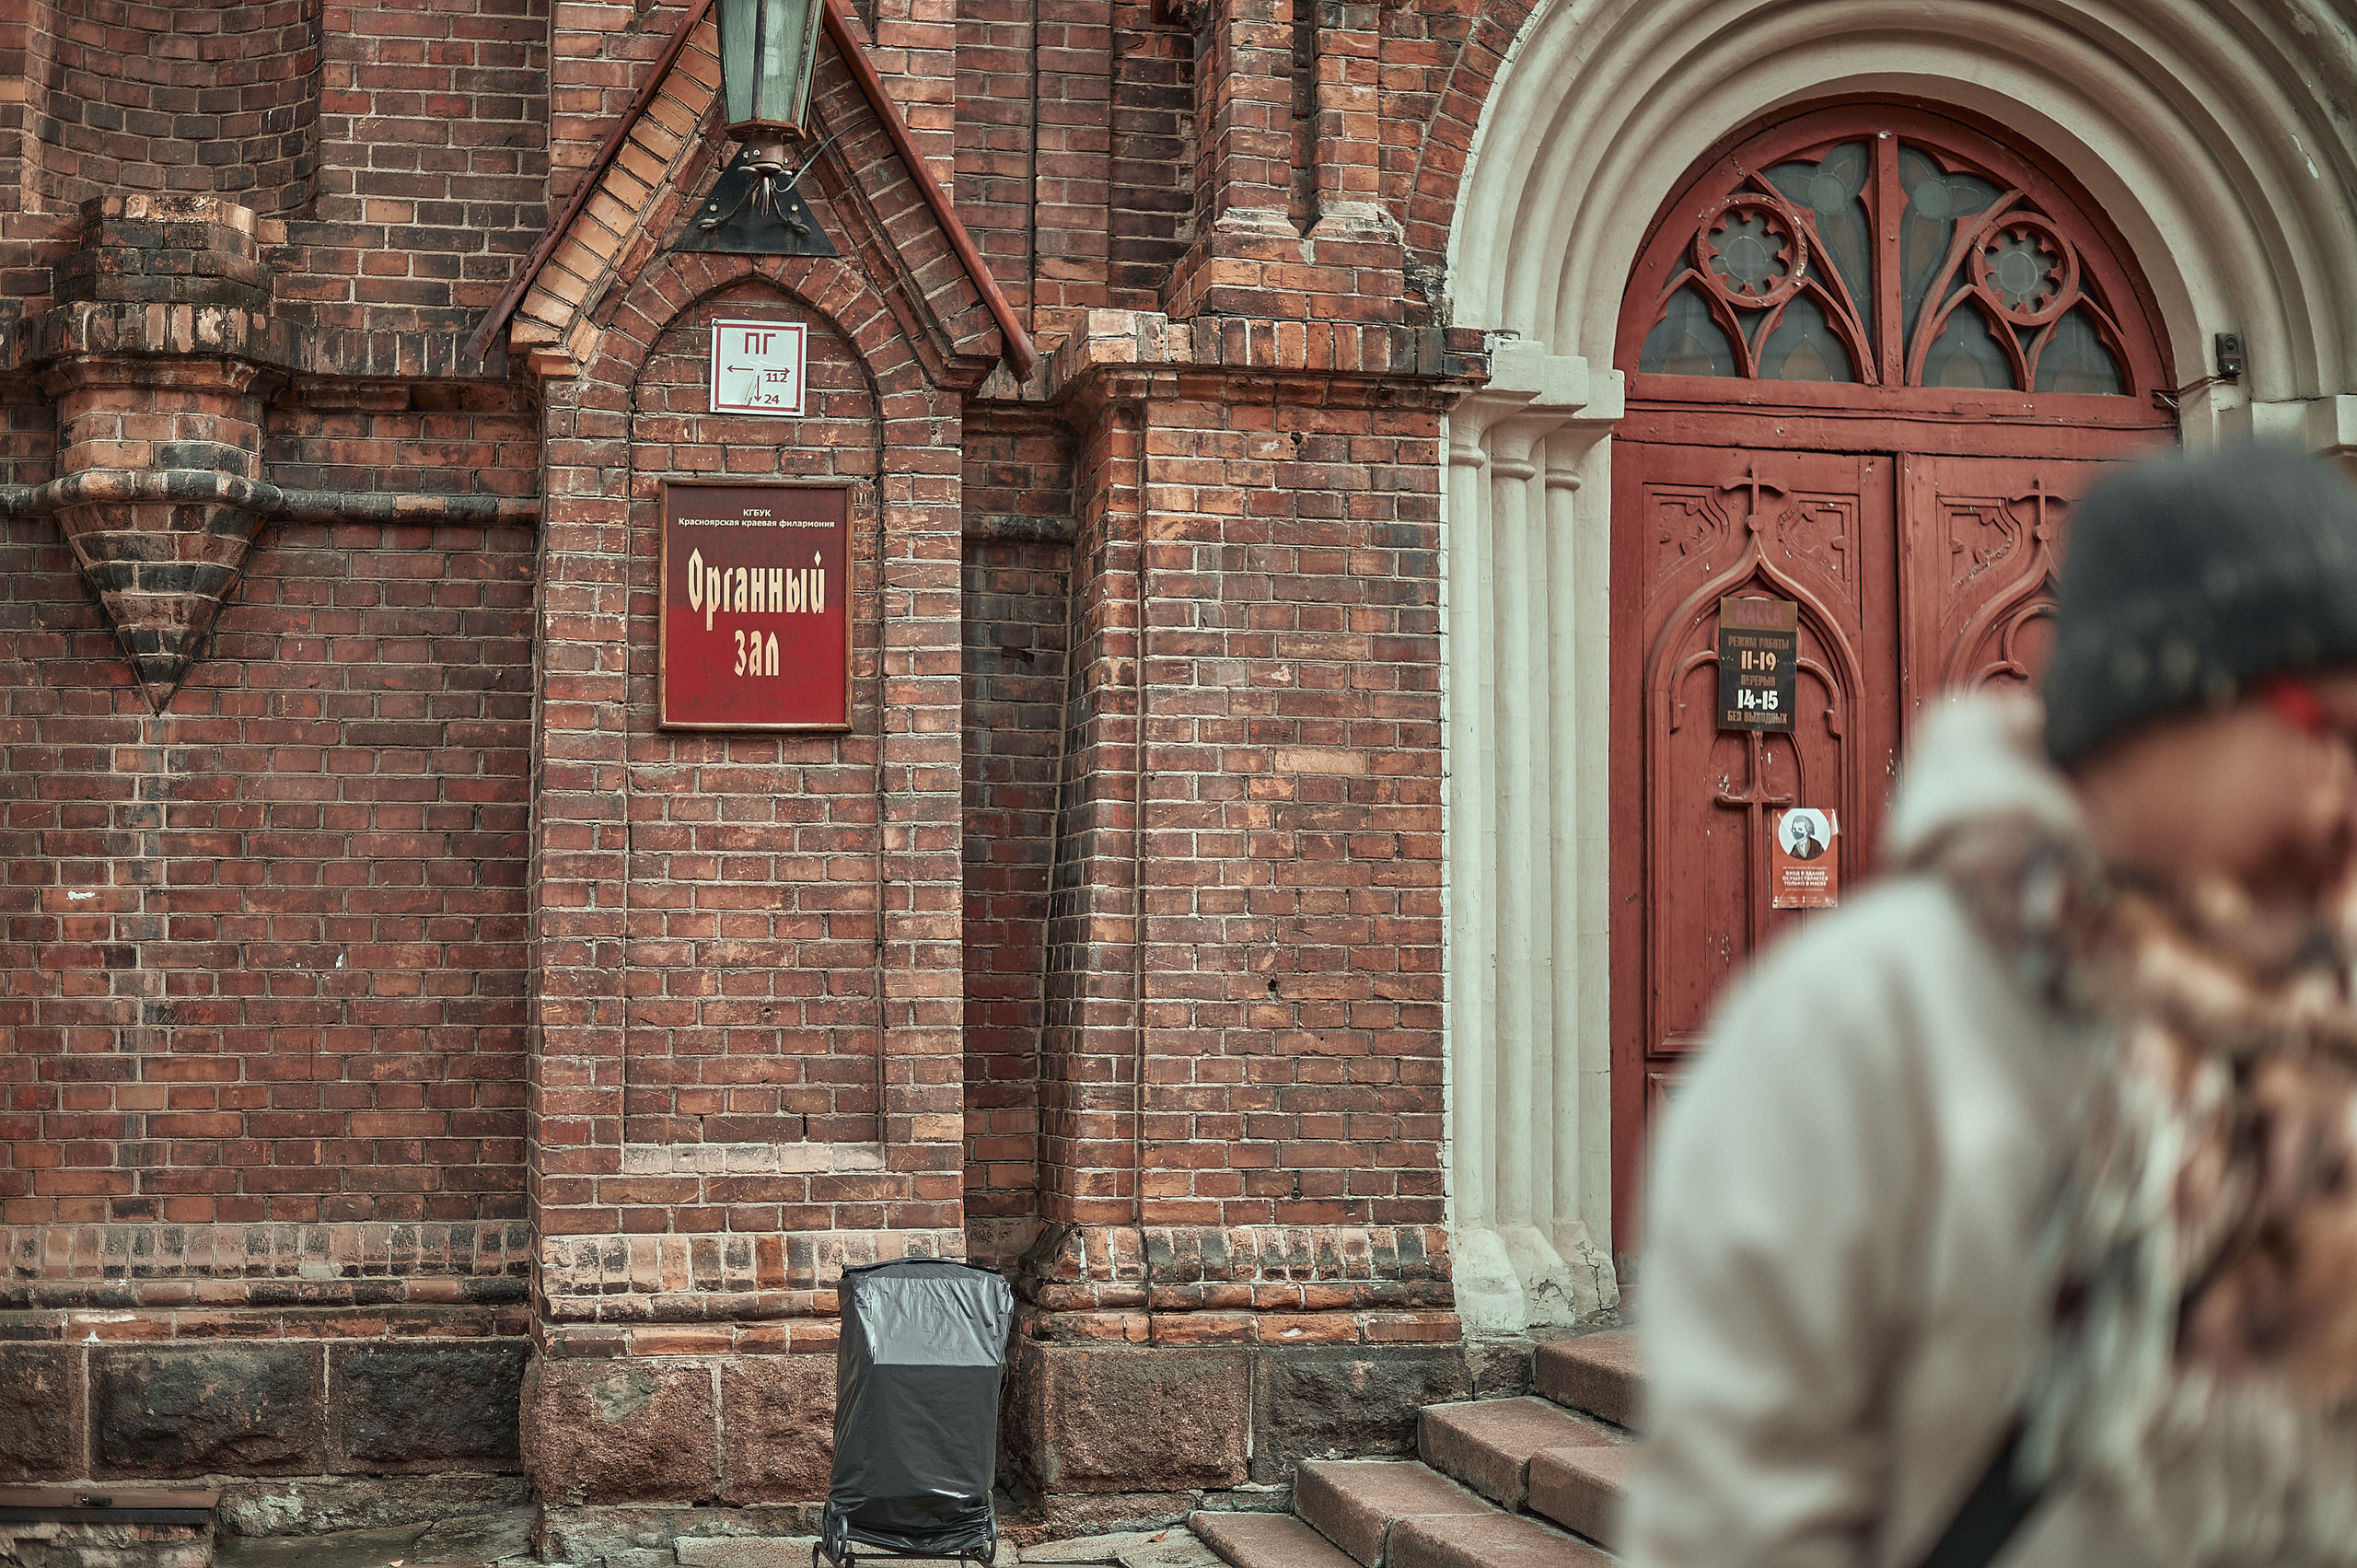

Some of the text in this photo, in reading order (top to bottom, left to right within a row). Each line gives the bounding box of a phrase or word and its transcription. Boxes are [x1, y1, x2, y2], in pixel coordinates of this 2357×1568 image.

[745, 332, 776, 354] ПГ
[766, 373, 788, 383] 112
[764, 394, 780, 404] 24
[743, 508, 772, 517] КГБУК
[679, 517, 835, 528] Красноярская краевая филармония
[689, 547, 825, 631] Органный
[1736, 601, 1782, 626] КАССА
[1728, 635, 1789, 650] РЕЖИМ РАБОТЫ
[734, 629, 779, 677] зал
[1741, 650, 1777, 671] 11-19
[1740, 674, 1776, 686] ПЕРЕРЫВ
[1737, 689, 1779, 711] 14-15
[1727, 710, 1788, 725] БЕЗ ВЫХОДНЫХ
